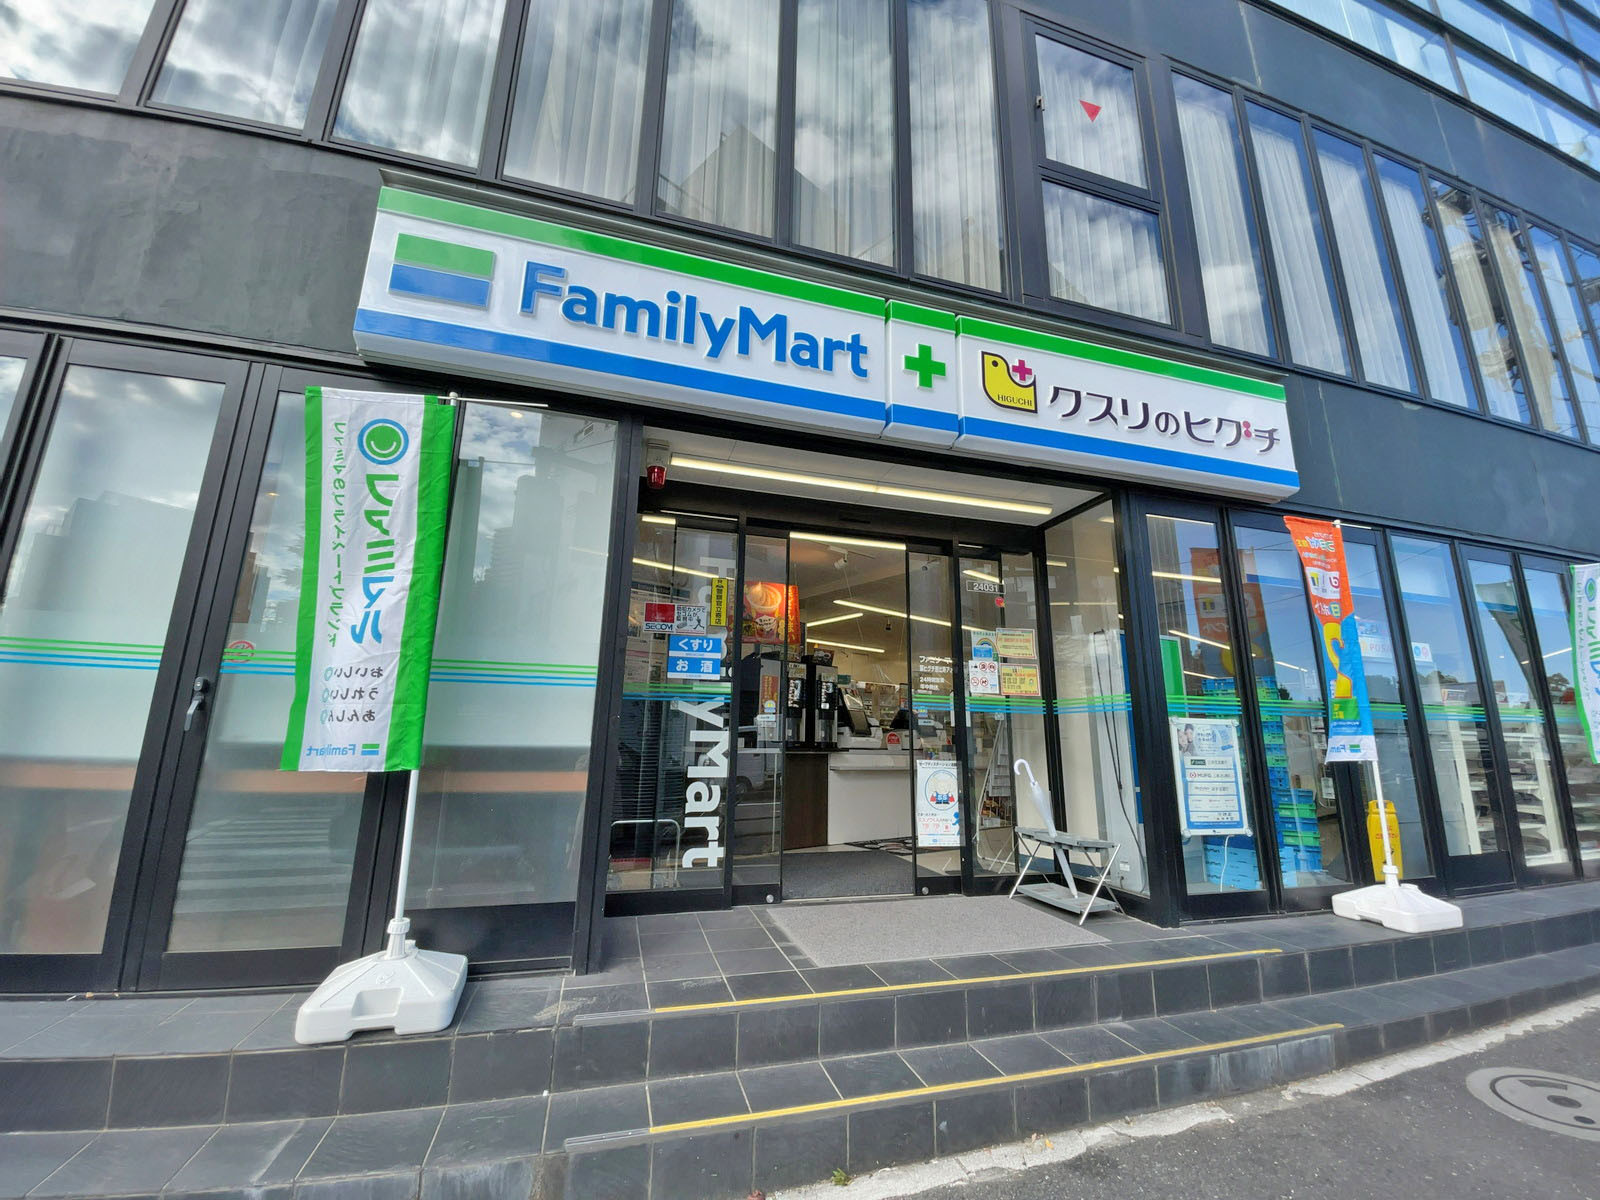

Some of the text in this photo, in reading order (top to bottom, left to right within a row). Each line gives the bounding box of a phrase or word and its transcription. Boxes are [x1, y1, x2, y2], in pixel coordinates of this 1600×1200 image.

[520, 261, 869, 379] FamilyMart
[997, 394, 1033, 407] HIGUCHI
[1049, 385, 1281, 454] クスリのヒグチ
[973, 582, 999, 593] 24031
[645, 622, 673, 631] SECOM
[678, 638, 713, 652] くすり
